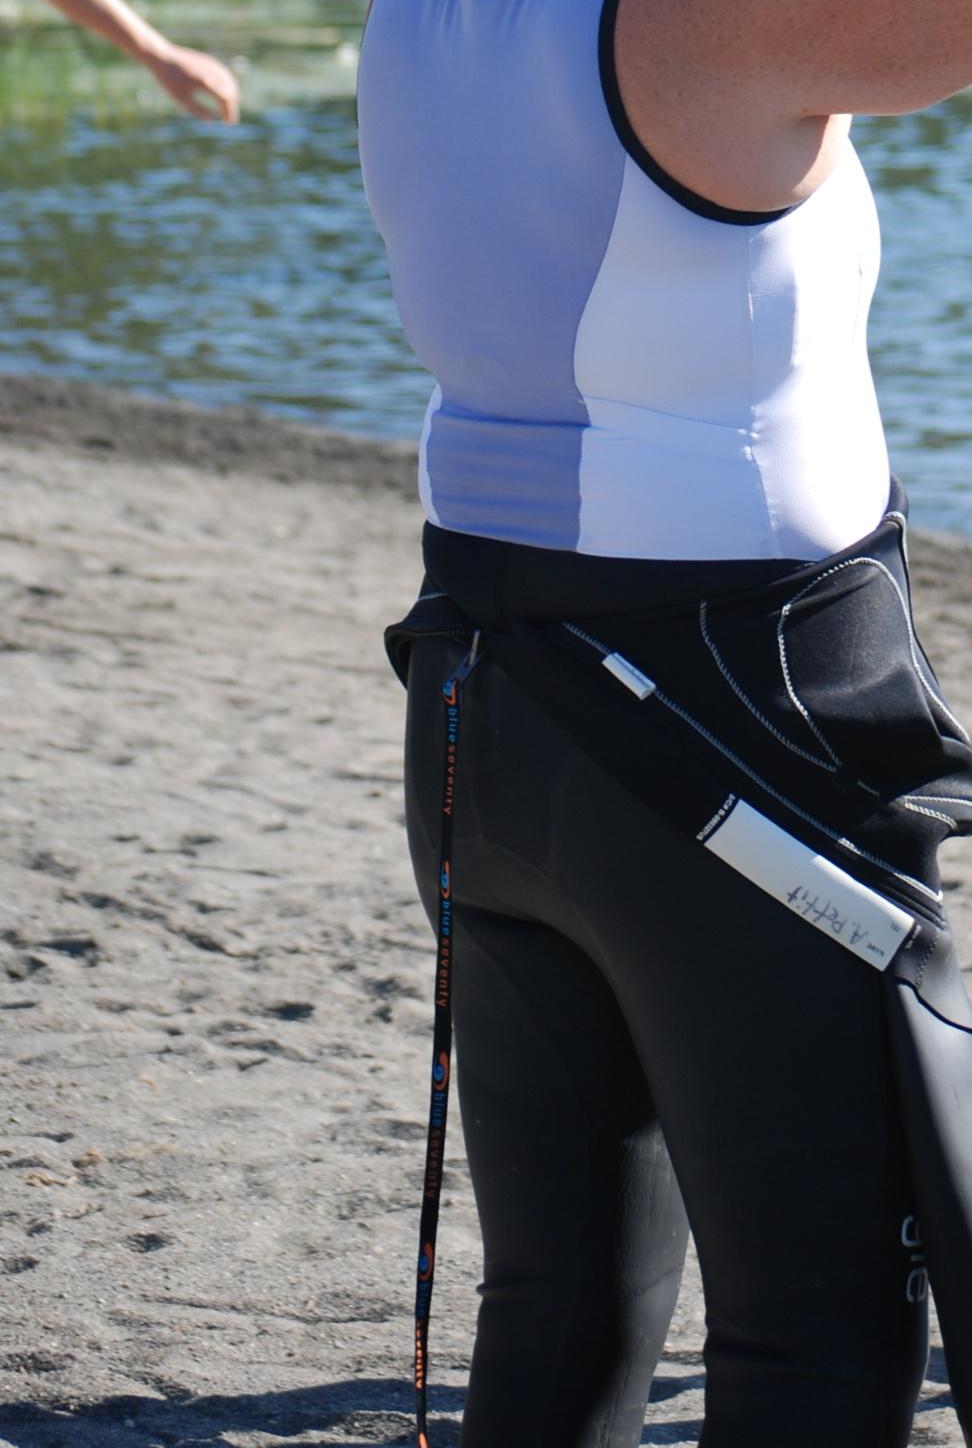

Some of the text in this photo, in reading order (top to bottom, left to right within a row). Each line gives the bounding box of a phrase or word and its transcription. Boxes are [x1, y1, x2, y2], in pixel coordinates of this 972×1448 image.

[442, 707, 458, 815] blueseventy
[437, 901, 450, 1007] blueseventy
[786, 885, 848, 934] Pettit
[425, 1093, 444, 1198] blueseventy
